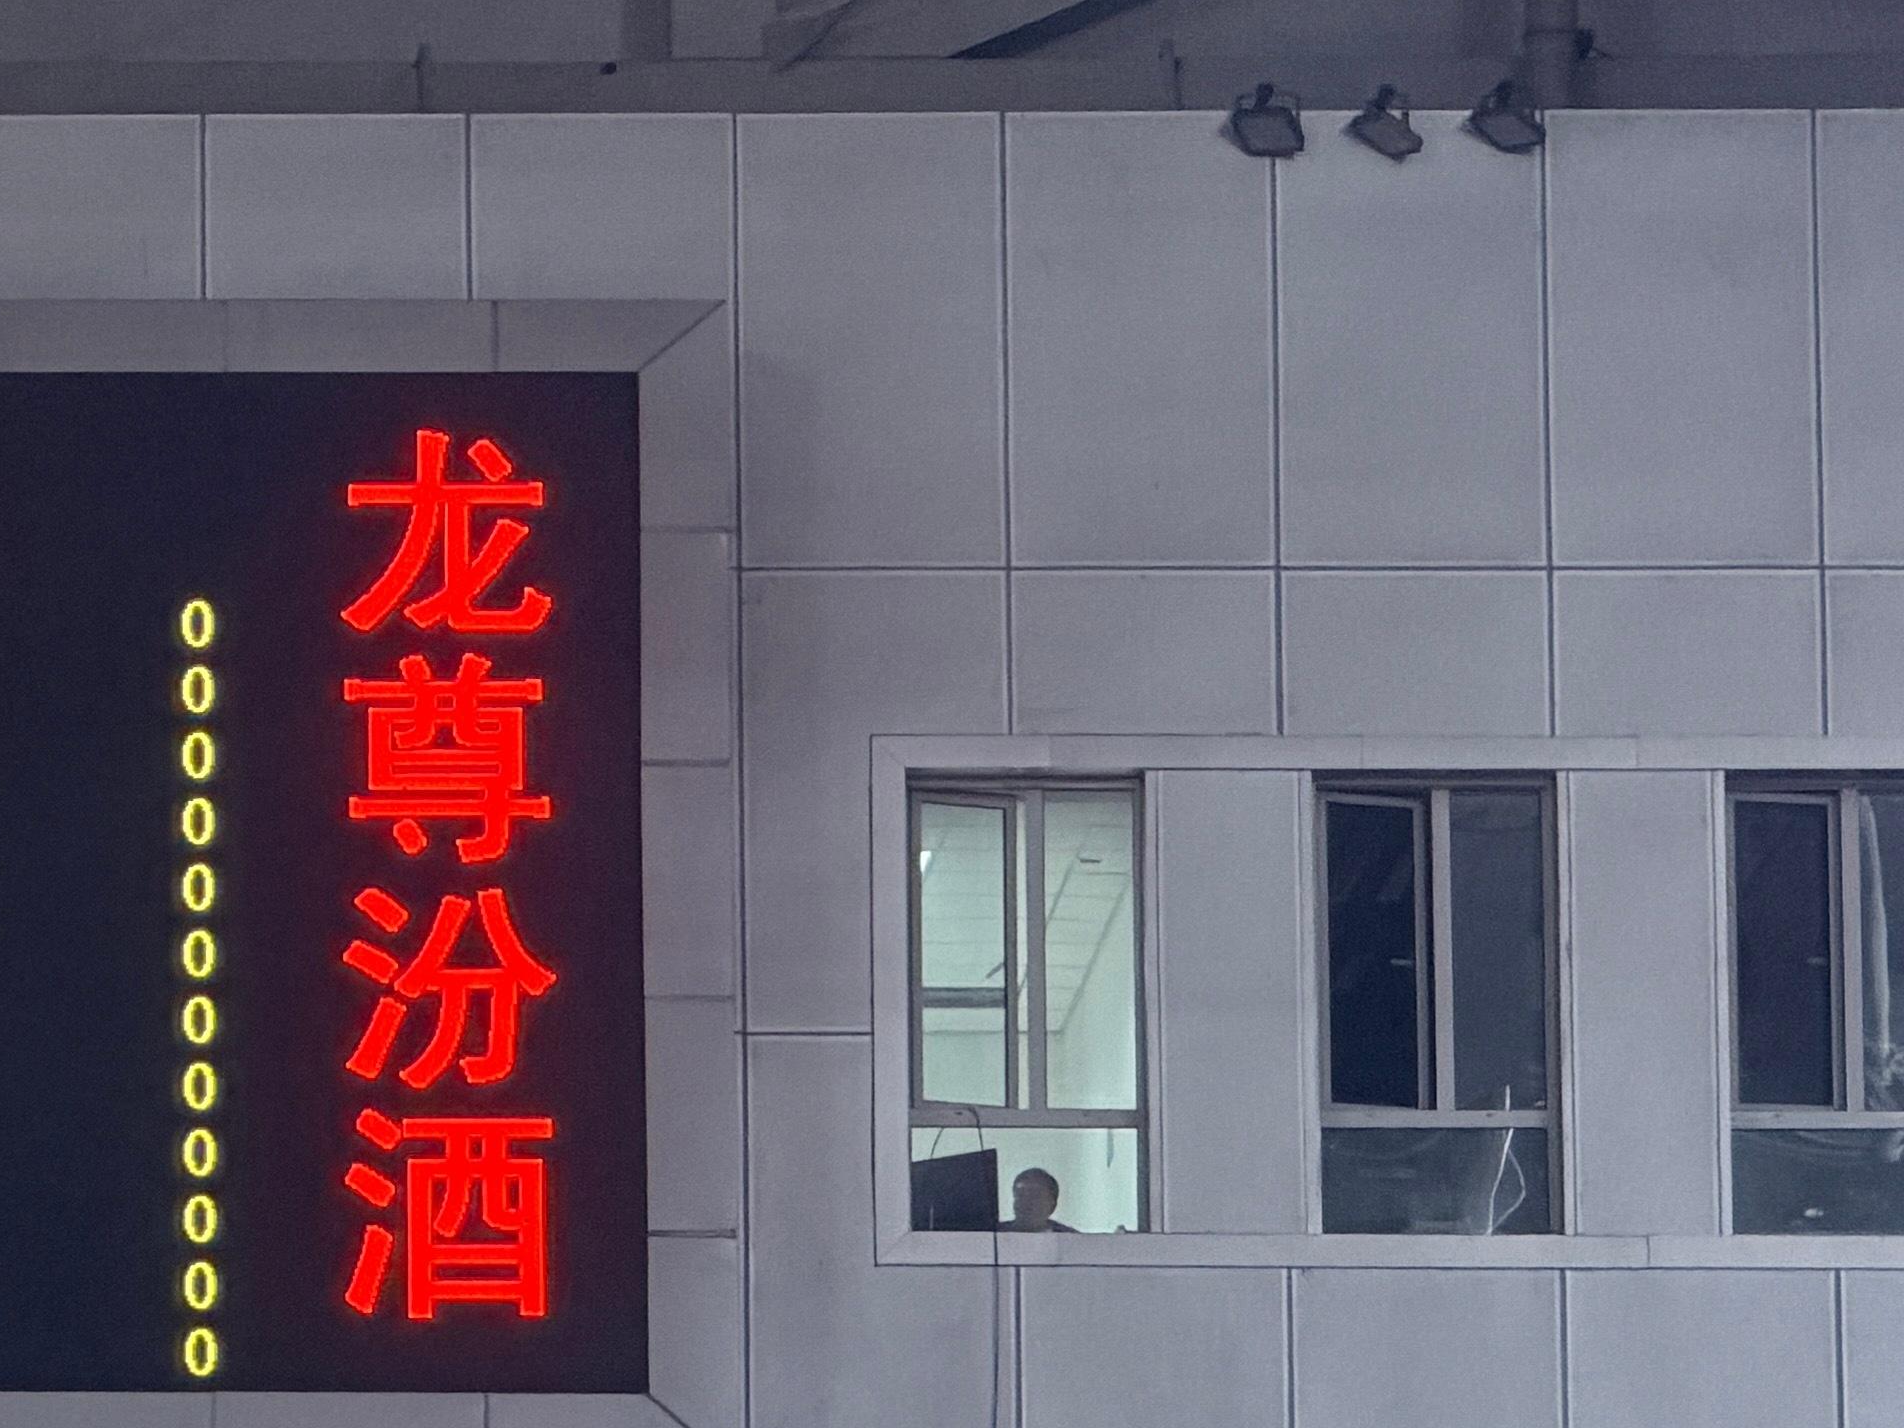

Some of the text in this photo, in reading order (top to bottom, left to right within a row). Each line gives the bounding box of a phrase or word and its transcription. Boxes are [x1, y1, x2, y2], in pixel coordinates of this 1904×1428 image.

[182, 601, 214, 647] 0
[182, 666, 215, 713] 0
[182, 732, 215, 779] 0
[183, 798, 215, 845] 0
[183, 864, 215, 911] 0
[341, 429, 556, 1321] 龙尊汾酒
[183, 930, 215, 977] 0
[183, 997, 216, 1044] 0
[183, 1063, 216, 1110] 0
[184, 1129, 217, 1176] 0
[184, 1196, 217, 1242] 0
[185, 1262, 217, 1309] 0
[185, 1329, 217, 1376] 0
